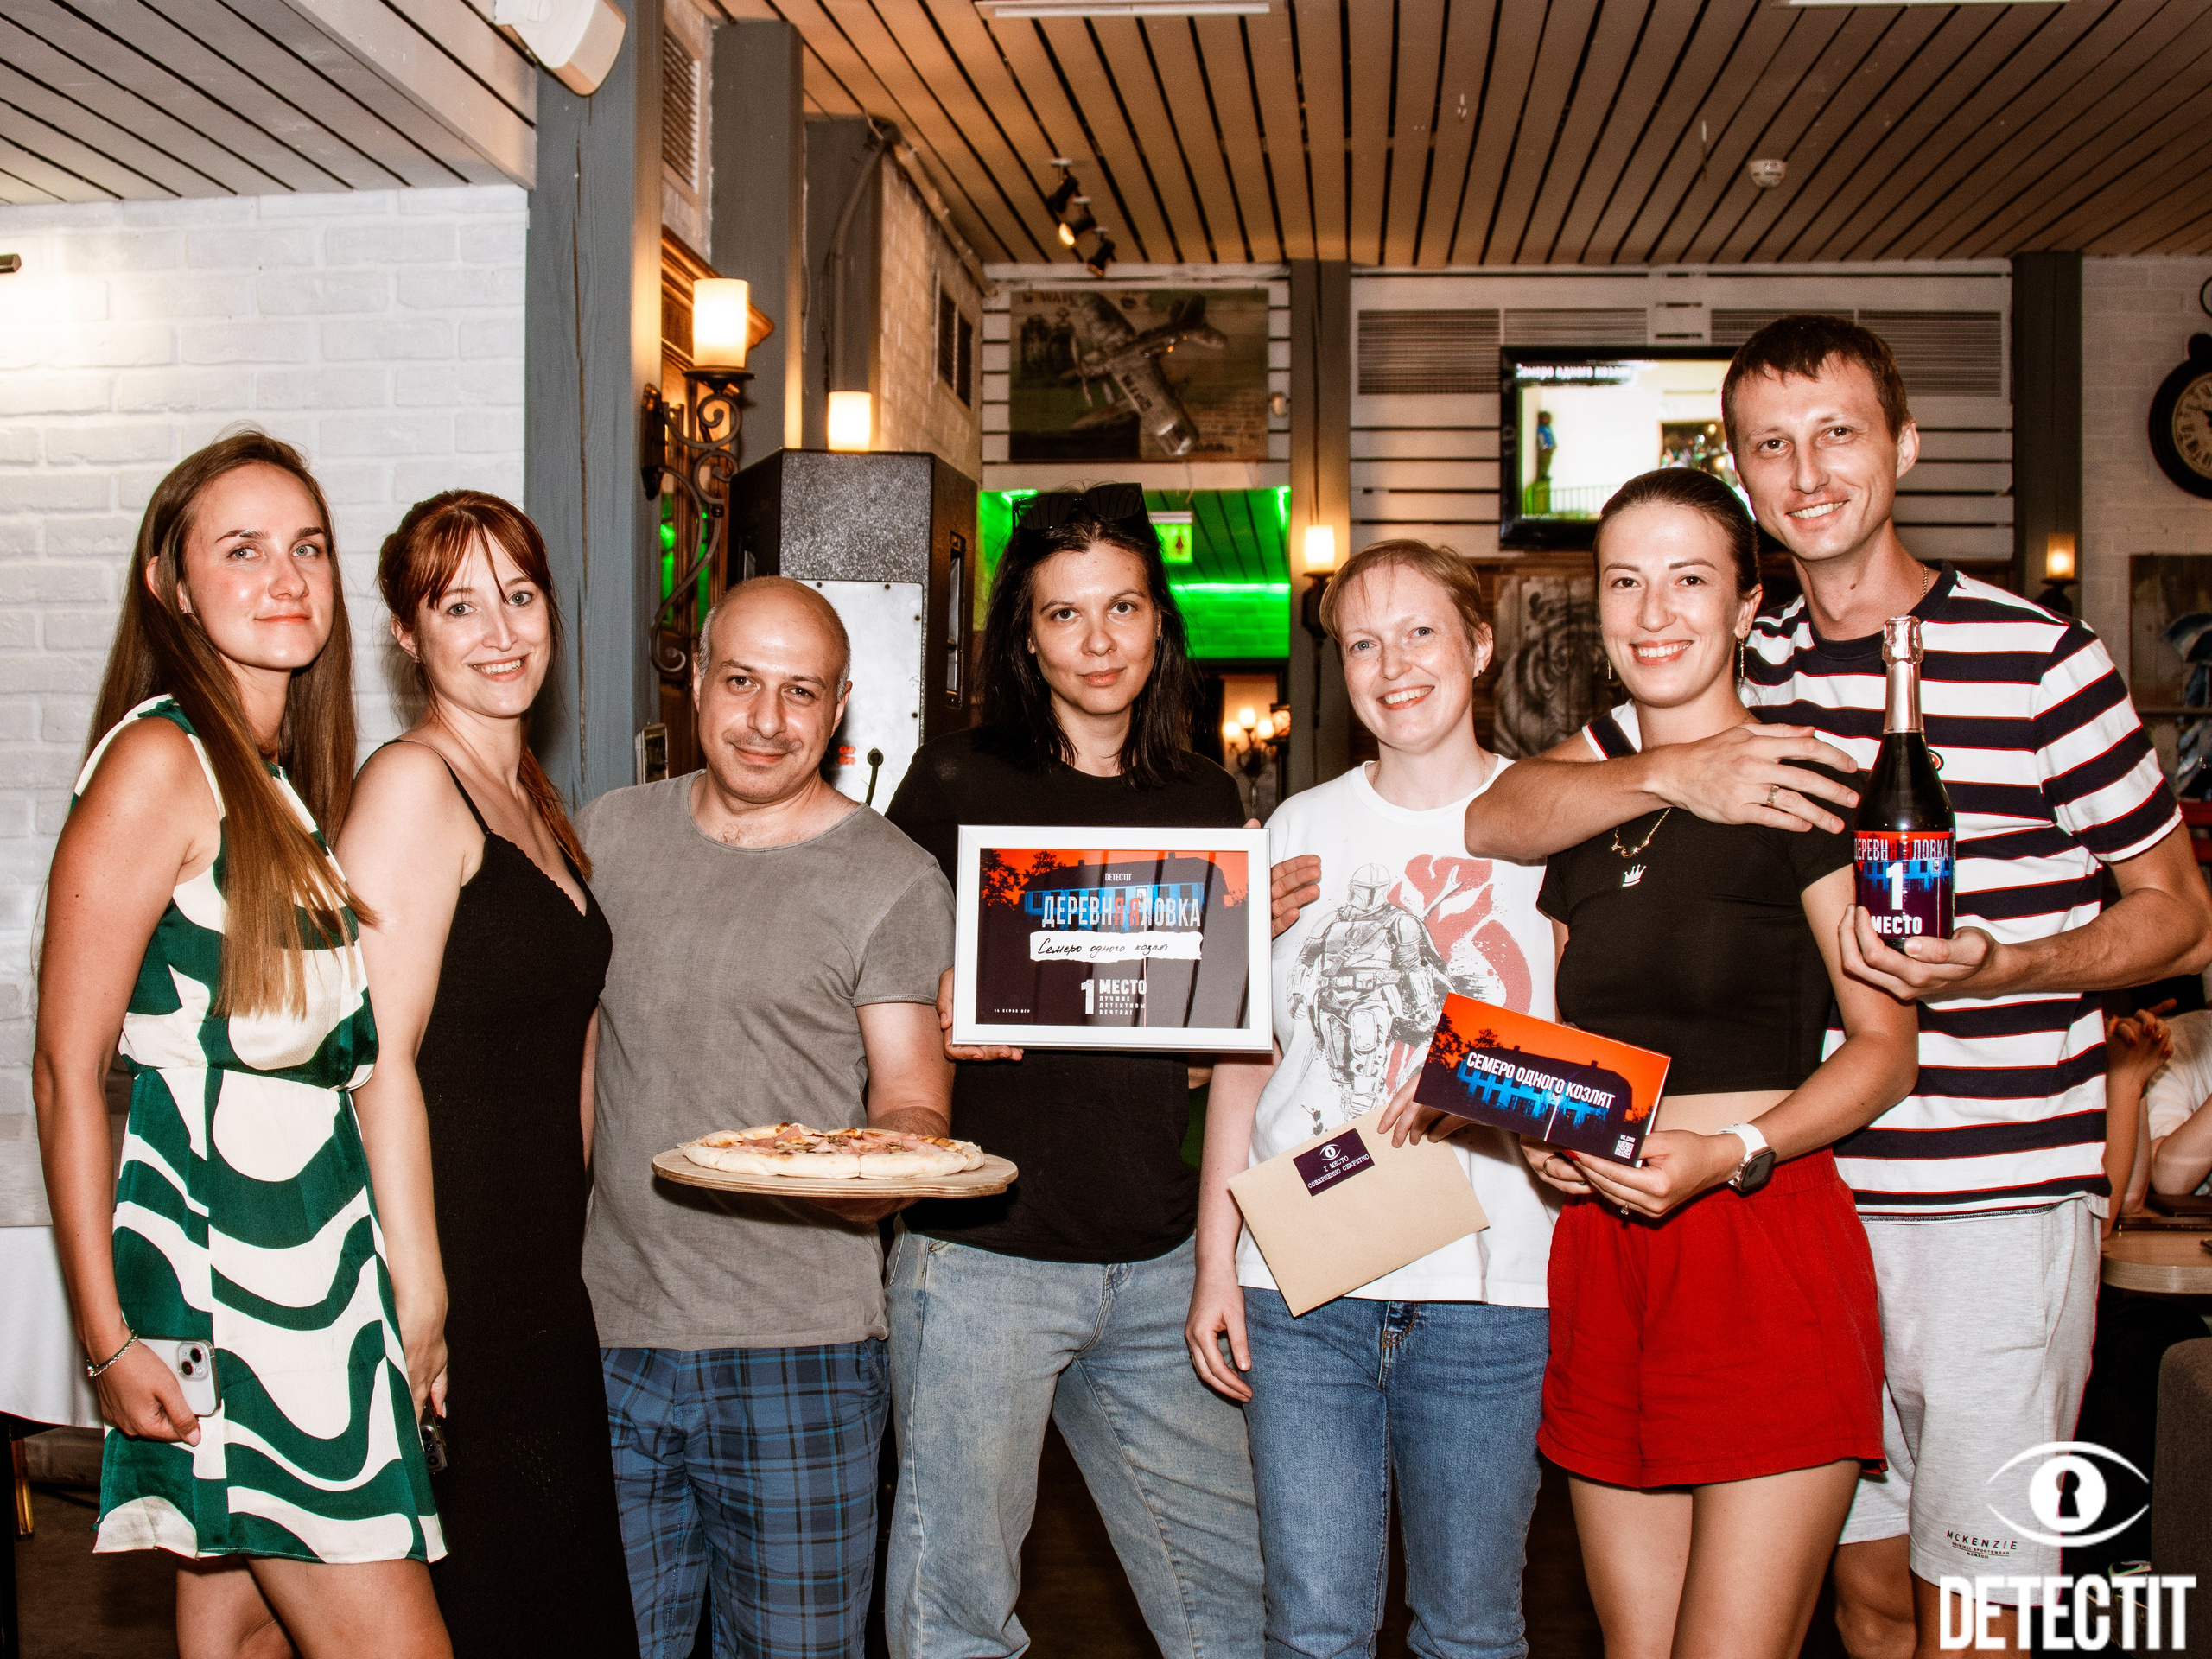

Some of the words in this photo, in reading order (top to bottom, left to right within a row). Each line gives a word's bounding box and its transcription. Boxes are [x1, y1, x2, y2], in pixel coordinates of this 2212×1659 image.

[1105, 873, 1132, 881] DETECTIT
[1886, 862, 1903, 910] 1
[1041, 896, 1124, 928] ДЕРЕВНЯ
[1129, 897, 1201, 926] ЯЛОВКА
[1871, 916, 1923, 934] МЕСТО
[1038, 938, 1082, 956] Семеро
[1090, 944, 1125, 958] одного
[1134, 944, 1169, 956] козлят
[1081, 979, 1094, 1014] 1
[1099, 979, 1147, 995] МЕСТО
[1466, 1052, 1516, 1079] СЕМЕРО
[1516, 1067, 1566, 1095] ОДНОГО
[1565, 1084, 1615, 1109] КОЗЛЯТ
[1307, 1168, 1341, 1188] СОВЕРШЕННО
[1342, 1154, 1370, 1171] СЕКРЕТНО
[1329, 1155, 1349, 1169] МЕСТО
[1946, 1529, 2018, 1549] MCKENZIE
